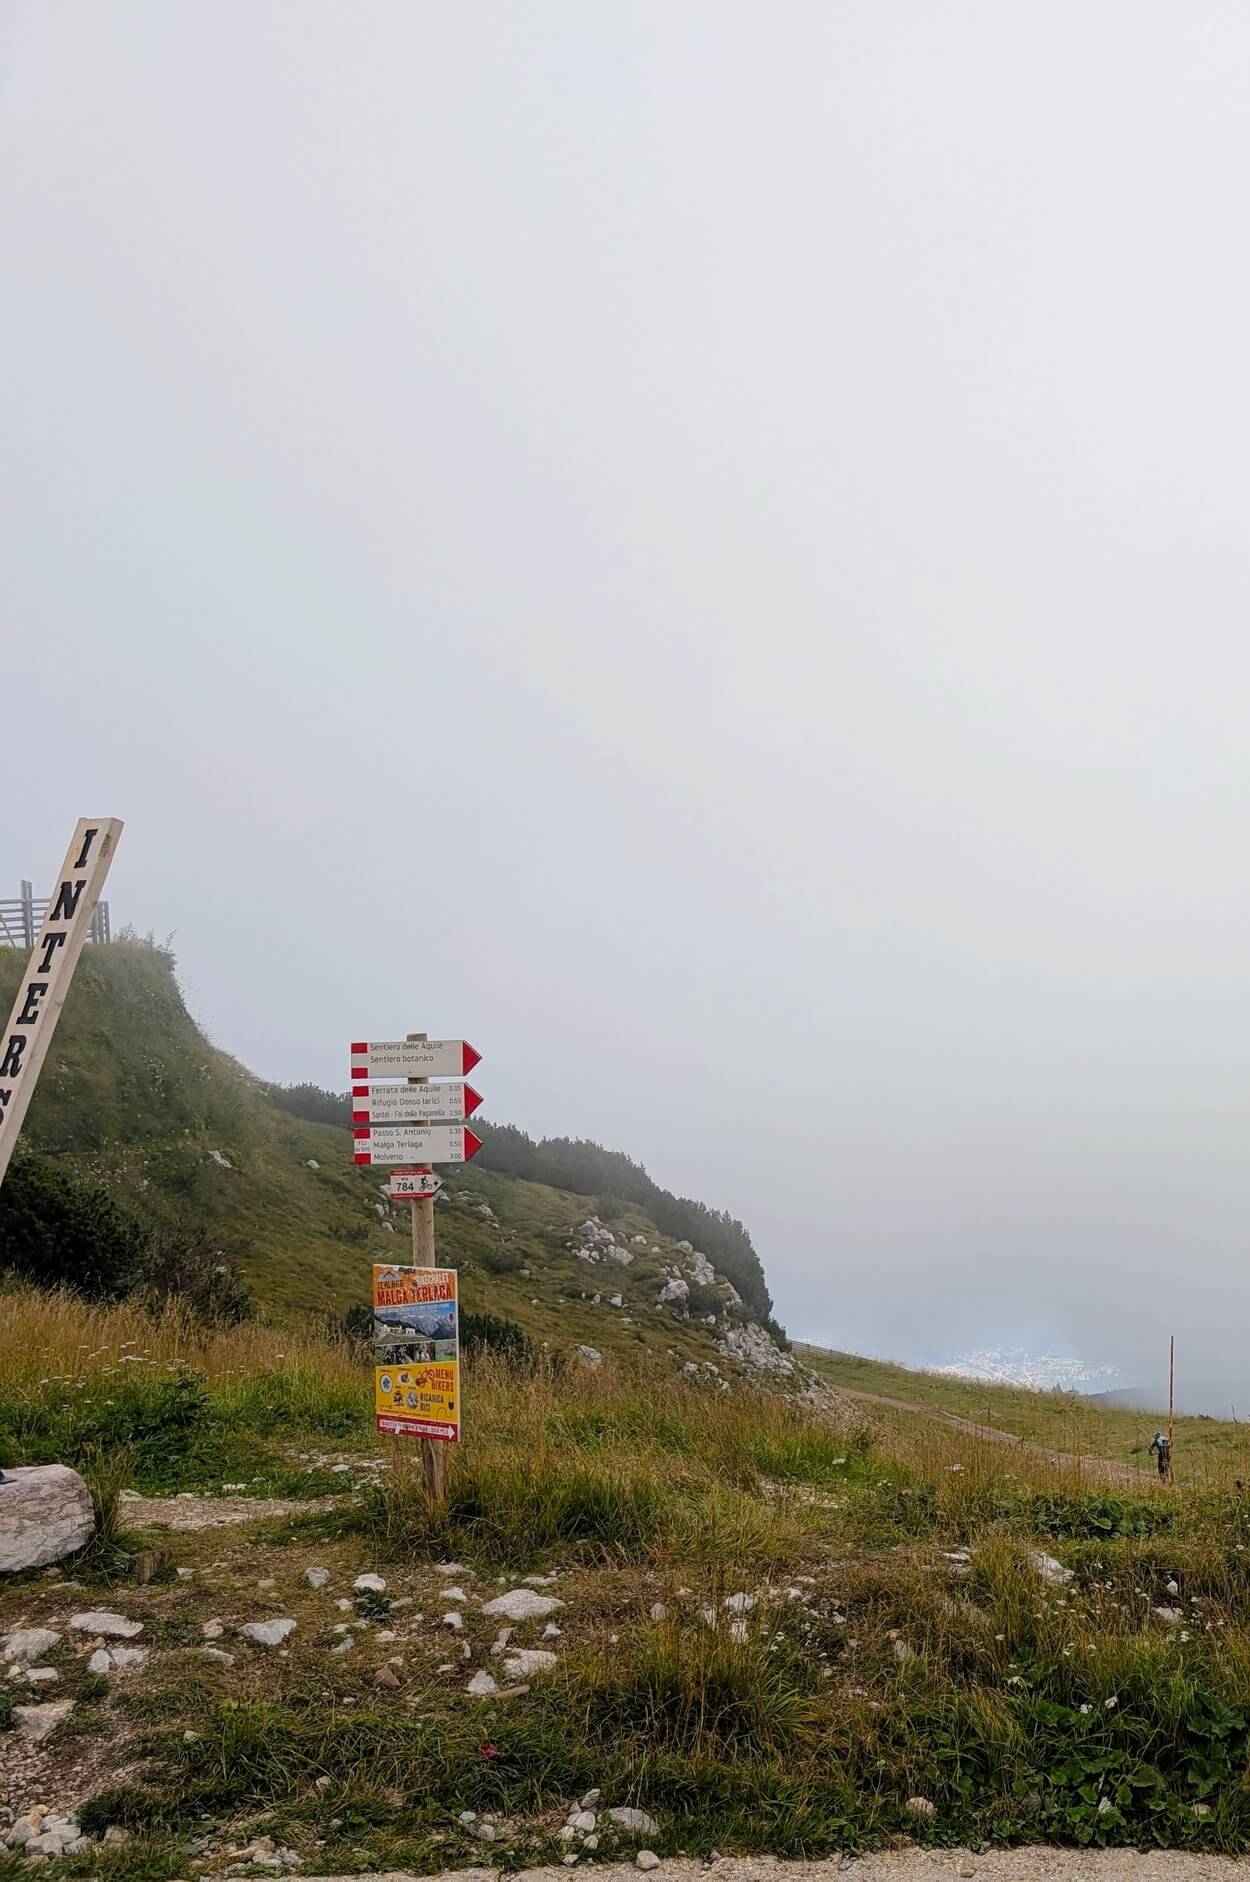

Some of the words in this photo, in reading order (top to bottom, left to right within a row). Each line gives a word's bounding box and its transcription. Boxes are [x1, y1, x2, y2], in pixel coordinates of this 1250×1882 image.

[370, 1043, 400, 1052] Sentiero
[402, 1042, 419, 1050] delle
[370, 1055, 400, 1064] Sentiero
[402, 1054, 434, 1062] botanico
[371, 1087, 398, 1095] Ferrata
[401, 1086, 417, 1094] delle
[420, 1085, 441, 1094] Aquile
[372, 1099, 397, 1107] Rifugio
[373, 1129, 394, 1137] Passo
[404, 1128, 431, 1136] Antonio
[373, 1142, 395, 1150] Malga
[397, 1141, 423, 1149] Terlaga
[396, 1182, 414, 1191] 784
[377, 1288, 408, 1305] MALGA
[410, 1283, 452, 1303] TERLAGA
[436, 1367, 454, 1380] MENU
[431, 1380, 454, 1392] BIKERS
